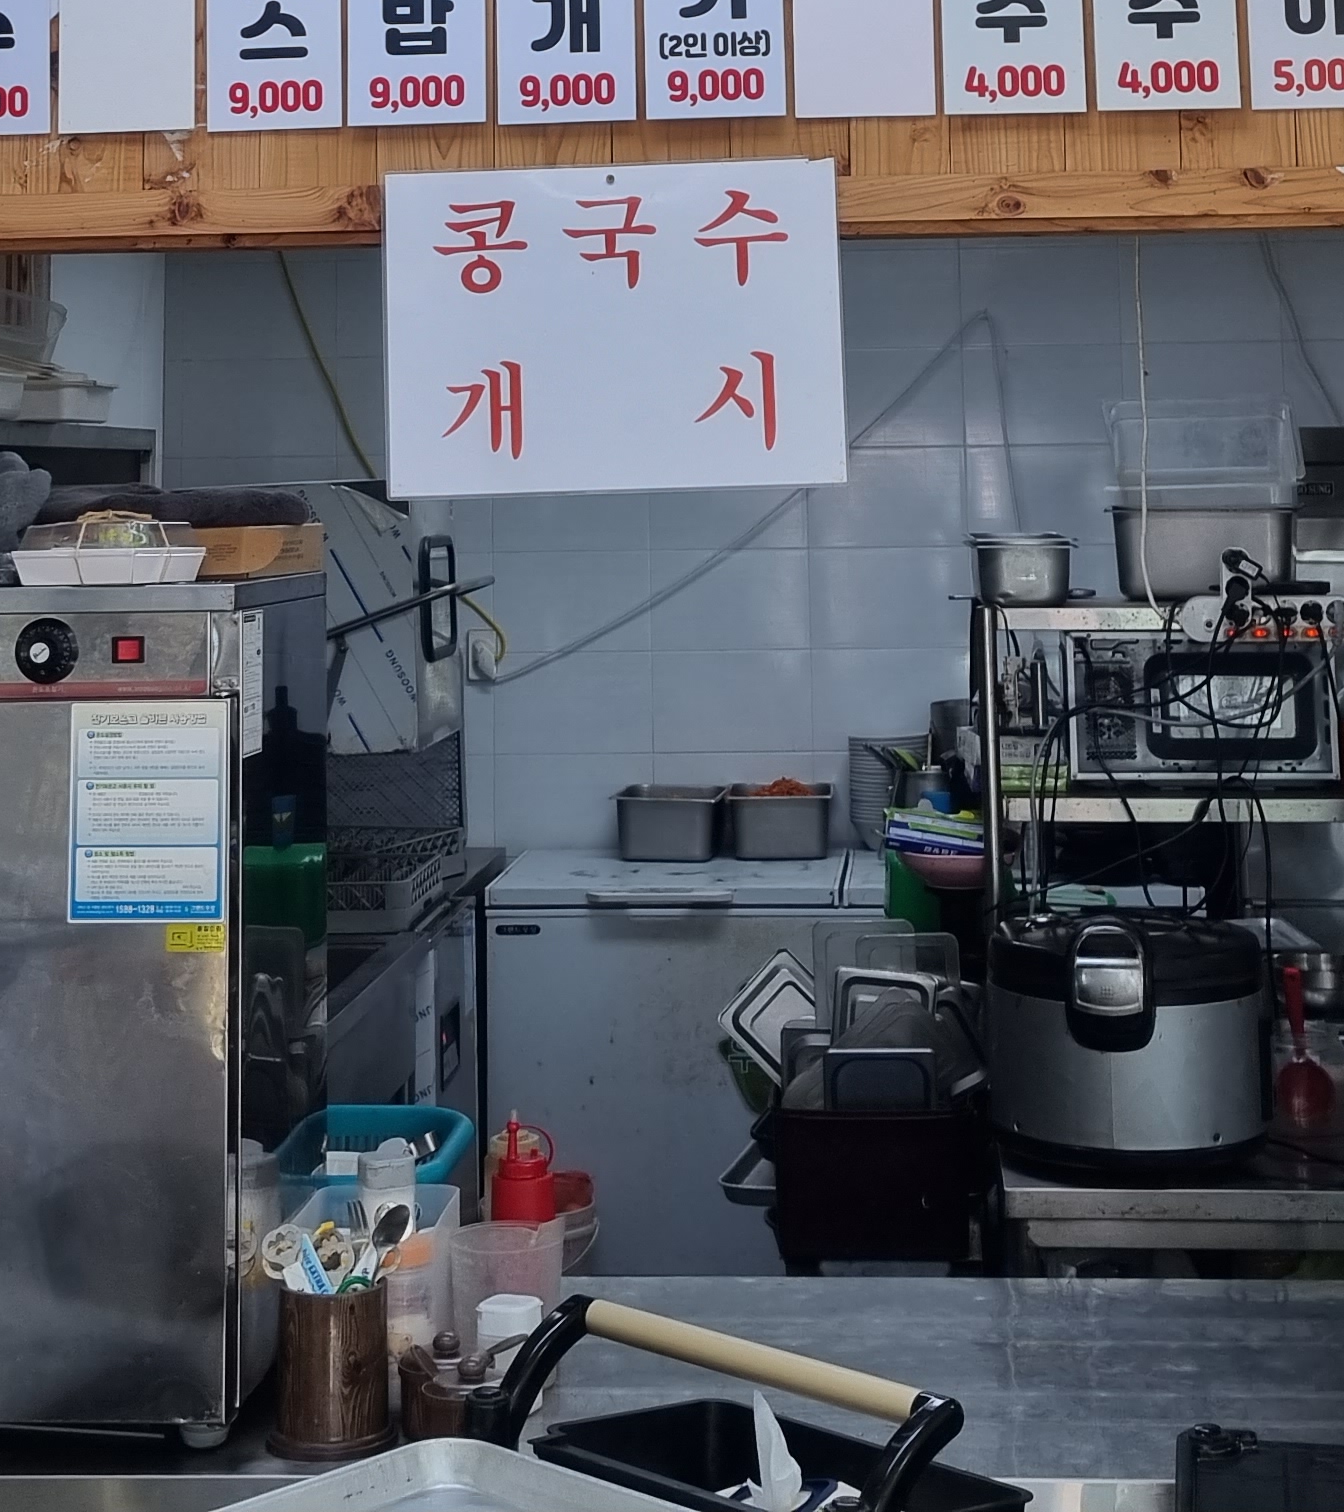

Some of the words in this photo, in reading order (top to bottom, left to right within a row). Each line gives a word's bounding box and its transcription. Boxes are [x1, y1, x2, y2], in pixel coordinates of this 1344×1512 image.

[658, 31, 708, 61] (2인
[712, 28, 772, 58] 이상)
[228, 78, 324, 118] 9,000
[369, 73, 466, 111] 9,000
[519, 71, 616, 110] 9,000
[667, 67, 765, 105] 9,000
[964, 63, 1066, 102] 4,000
[1117, 59, 1220, 98] 4,000
[432, 188, 790, 295] 콩국수
